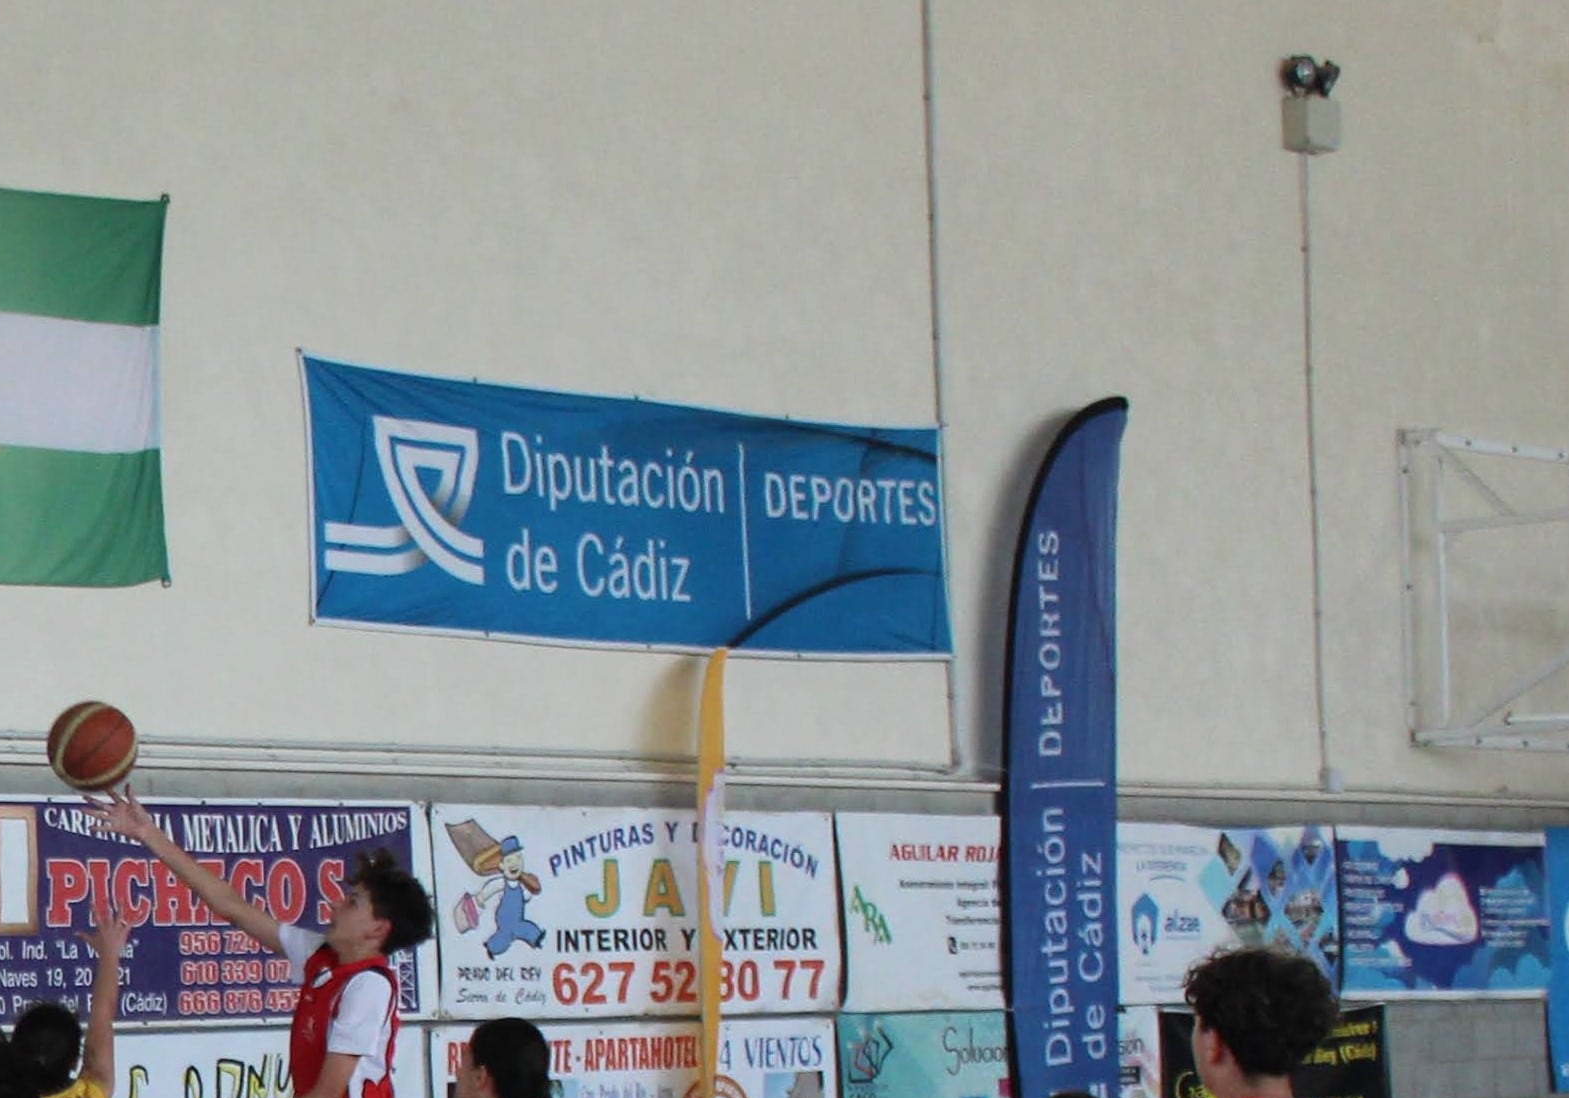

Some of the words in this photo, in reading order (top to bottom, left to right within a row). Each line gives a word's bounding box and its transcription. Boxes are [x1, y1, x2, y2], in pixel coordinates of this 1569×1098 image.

[501, 431, 726, 514] Diputación
[764, 473, 938, 527] DEPORTES
[506, 528, 558, 593] de
[577, 532, 692, 603] Cádiz
[1038, 529, 1061, 757] DEPORTES
[180, 814, 292, 854] METALICA
[291, 814, 301, 850] Y
[310, 810, 408, 850] ALUMINIOS
[549, 822, 655, 878] PINTURAS
[665, 821, 680, 843] Y
[889, 844, 960, 862] AGUILAR
[45, 857, 308, 928] PICHCO
[1036, 806, 1075, 1066] Diputación
[1077, 850, 1105, 985] Cádiz
[21, 939, 48, 960] Ind.
[179, 931, 222, 955] 956
[556, 928, 668, 953] INTERIOR
[681, 927, 698, 951] Y
[46, 967, 67, 989] 19,
[74, 967, 93, 987] 20
[180, 960, 220, 986] 610
[221, 959, 263, 984] 339
[495, 966, 514, 982] DEL
[552, 960, 636, 1005] 627
[650, 960, 699, 1004] 52
[773, 959, 825, 1001] 77
[121, 992, 168, 1017] (Cádiz)
[178, 989, 222, 1015] 666
[223, 988, 263, 1014] 876
[584, 1034, 699, 1072] APARTAHOTEL
[744, 1035, 824, 1068] VIENTOS
[1080, 1006, 1107, 1060] de
